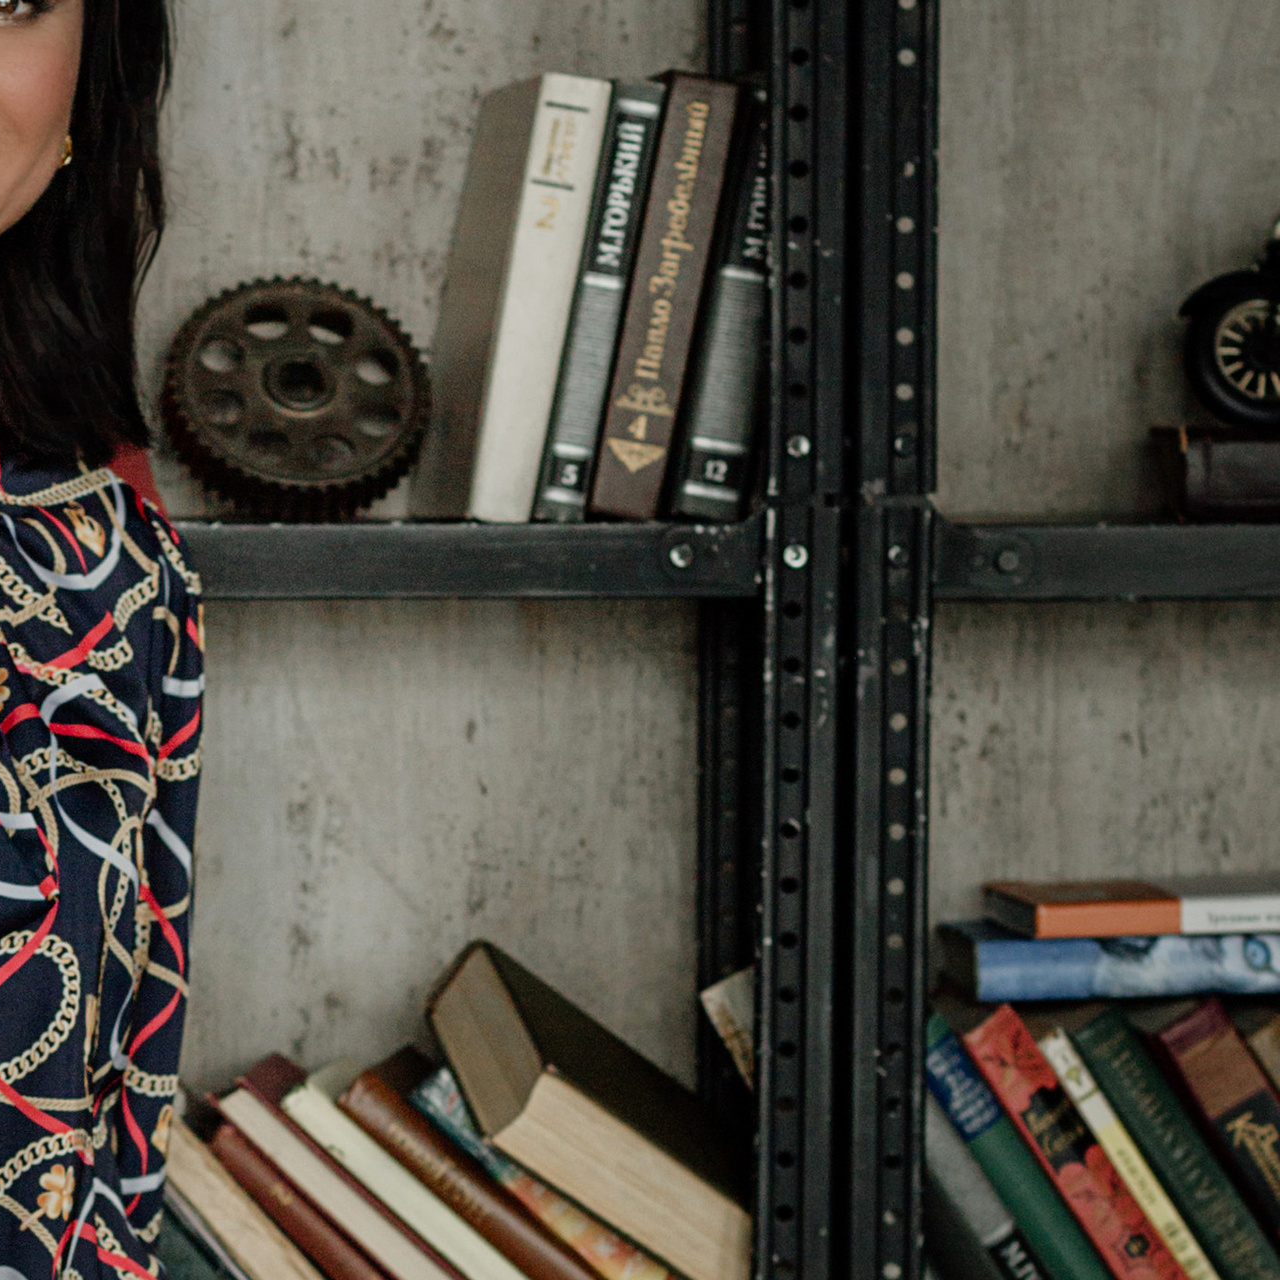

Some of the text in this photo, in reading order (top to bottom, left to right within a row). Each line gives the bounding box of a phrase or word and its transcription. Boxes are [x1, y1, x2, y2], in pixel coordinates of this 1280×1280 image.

[595, 119, 646, 269] М.ГОРЬКИЙ
[632, 295, 675, 382] Павло
[703, 459, 729, 484] 12
